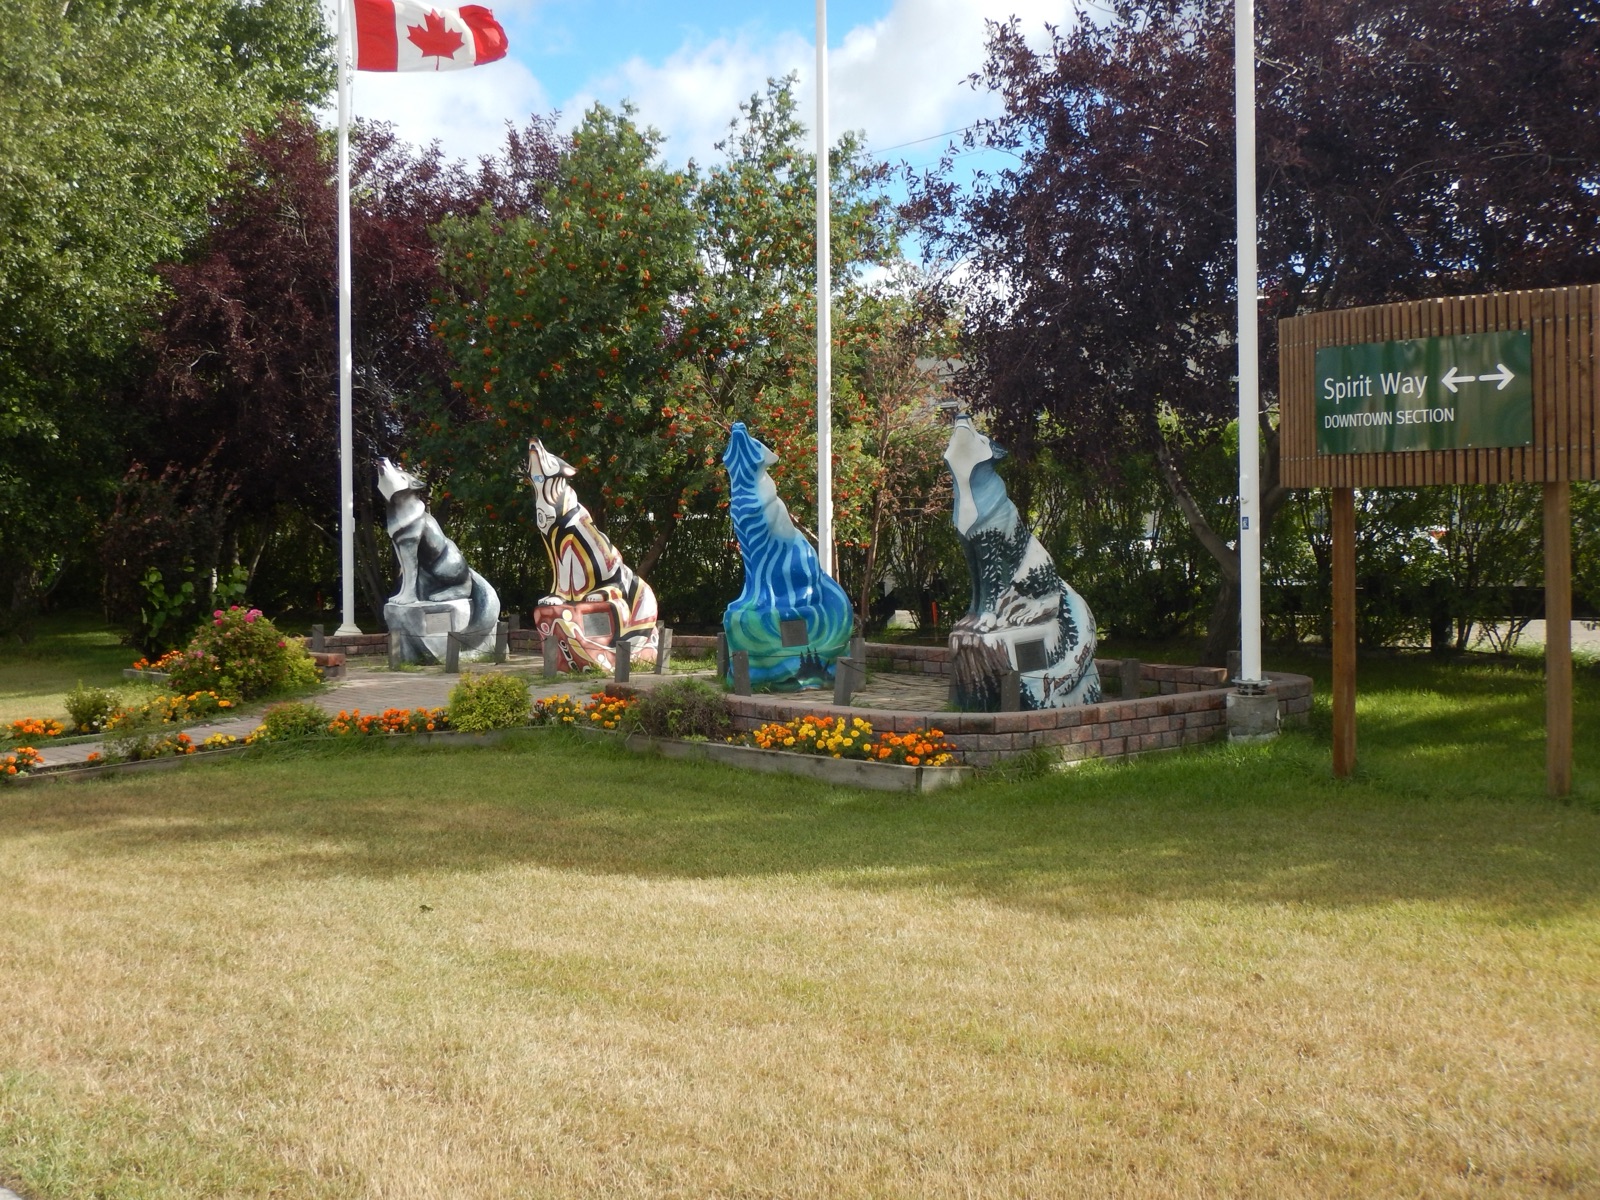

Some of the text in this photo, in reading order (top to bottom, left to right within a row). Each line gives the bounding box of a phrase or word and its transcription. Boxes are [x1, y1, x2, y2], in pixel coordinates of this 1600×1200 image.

[1324, 372, 1428, 404] Spirit Way
[1325, 408, 1455, 429] DOWNTOWN SECTION
